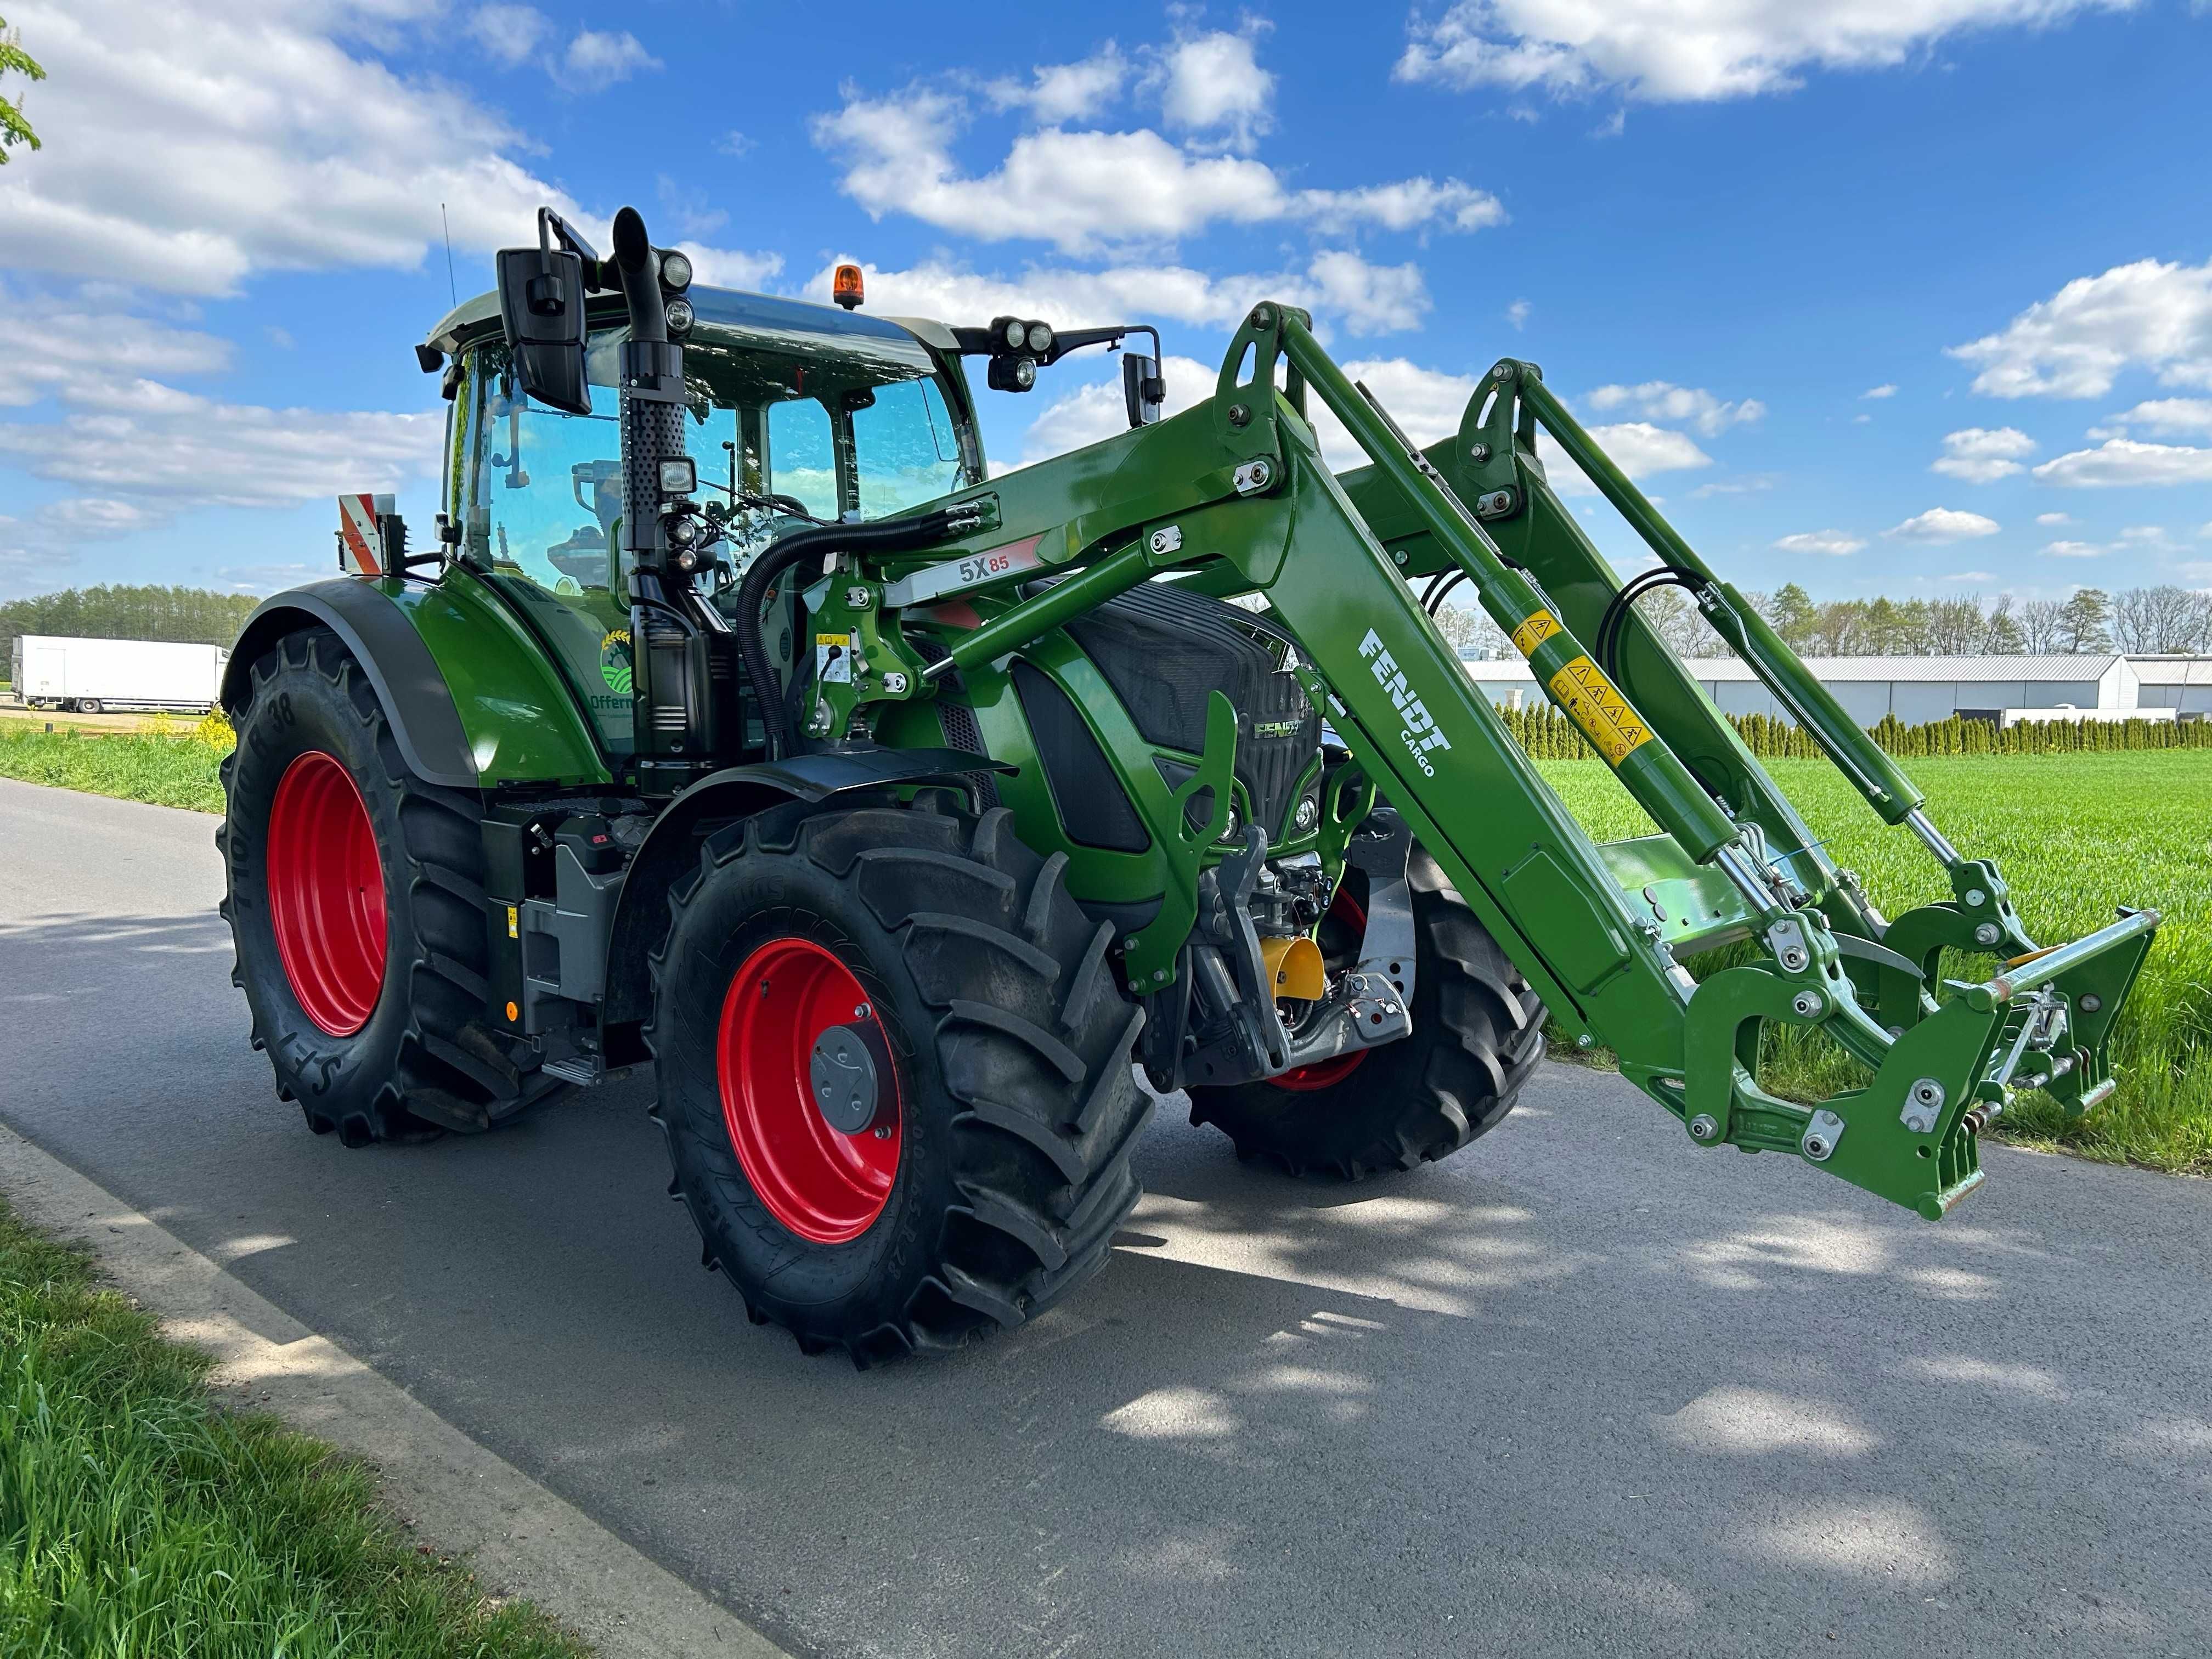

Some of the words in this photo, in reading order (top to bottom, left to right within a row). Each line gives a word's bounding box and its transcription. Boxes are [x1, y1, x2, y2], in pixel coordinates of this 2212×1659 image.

[1358, 627, 1452, 752] FENDT
[267, 691, 295, 735] 38
[1254, 720, 1304, 739] FENDT
[1401, 730, 1435, 777] CARGO
